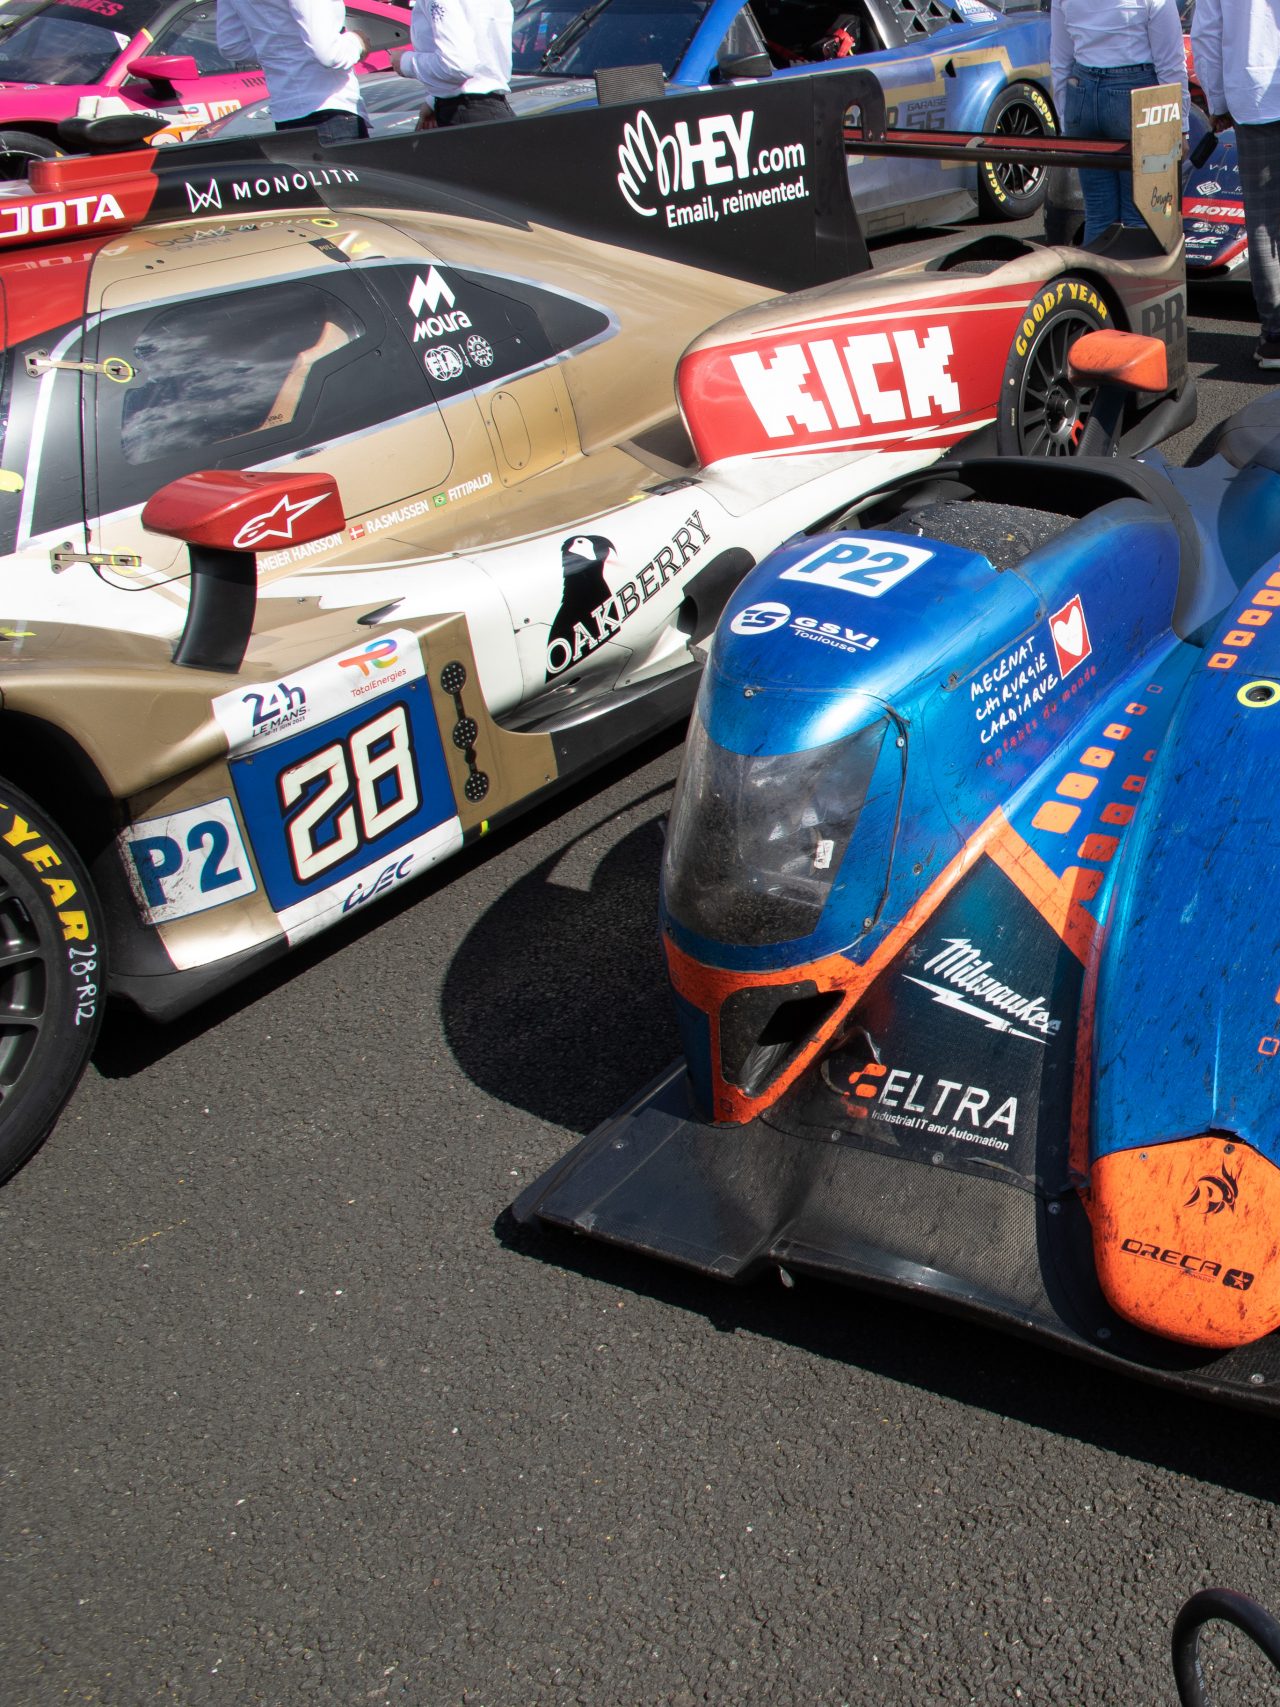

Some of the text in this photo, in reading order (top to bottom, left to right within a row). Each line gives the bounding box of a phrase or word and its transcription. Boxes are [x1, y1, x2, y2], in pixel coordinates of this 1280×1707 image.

[1136, 103, 1181, 128] JOTA
[233, 169, 359, 200] MONOLITH
[666, 175, 810, 228] Email, reinvented.
[0, 193, 125, 237] JOTA
[729, 325, 961, 438] KICK
[448, 472, 493, 502] FITTIPALDI
[366, 500, 430, 534] RASMUSSEN
[292, 533, 343, 561] HANSSON
[797, 543, 910, 588] P2
[547, 509, 711, 675] OAKBERRY
[794, 616, 880, 648] GSVI
[794, 628, 857, 654] Toulouse
[351, 667, 407, 698] TotalEnergies
[970, 636, 1035, 702] MECENAT
[242, 682, 306, 727] 24h
[252, 707, 308, 738] LE MANS
[275, 700, 423, 885] 28
[128, 820, 242, 908] P2
[68, 944, 98, 1026] 28-R12
[923, 938, 1062, 1036] Milwaukee
[878, 1068, 1019, 1136] ELTRA
[872, 1109, 1010, 1151] Industrial IT and Automation
[1121, 1238, 1222, 1277] ORECA
